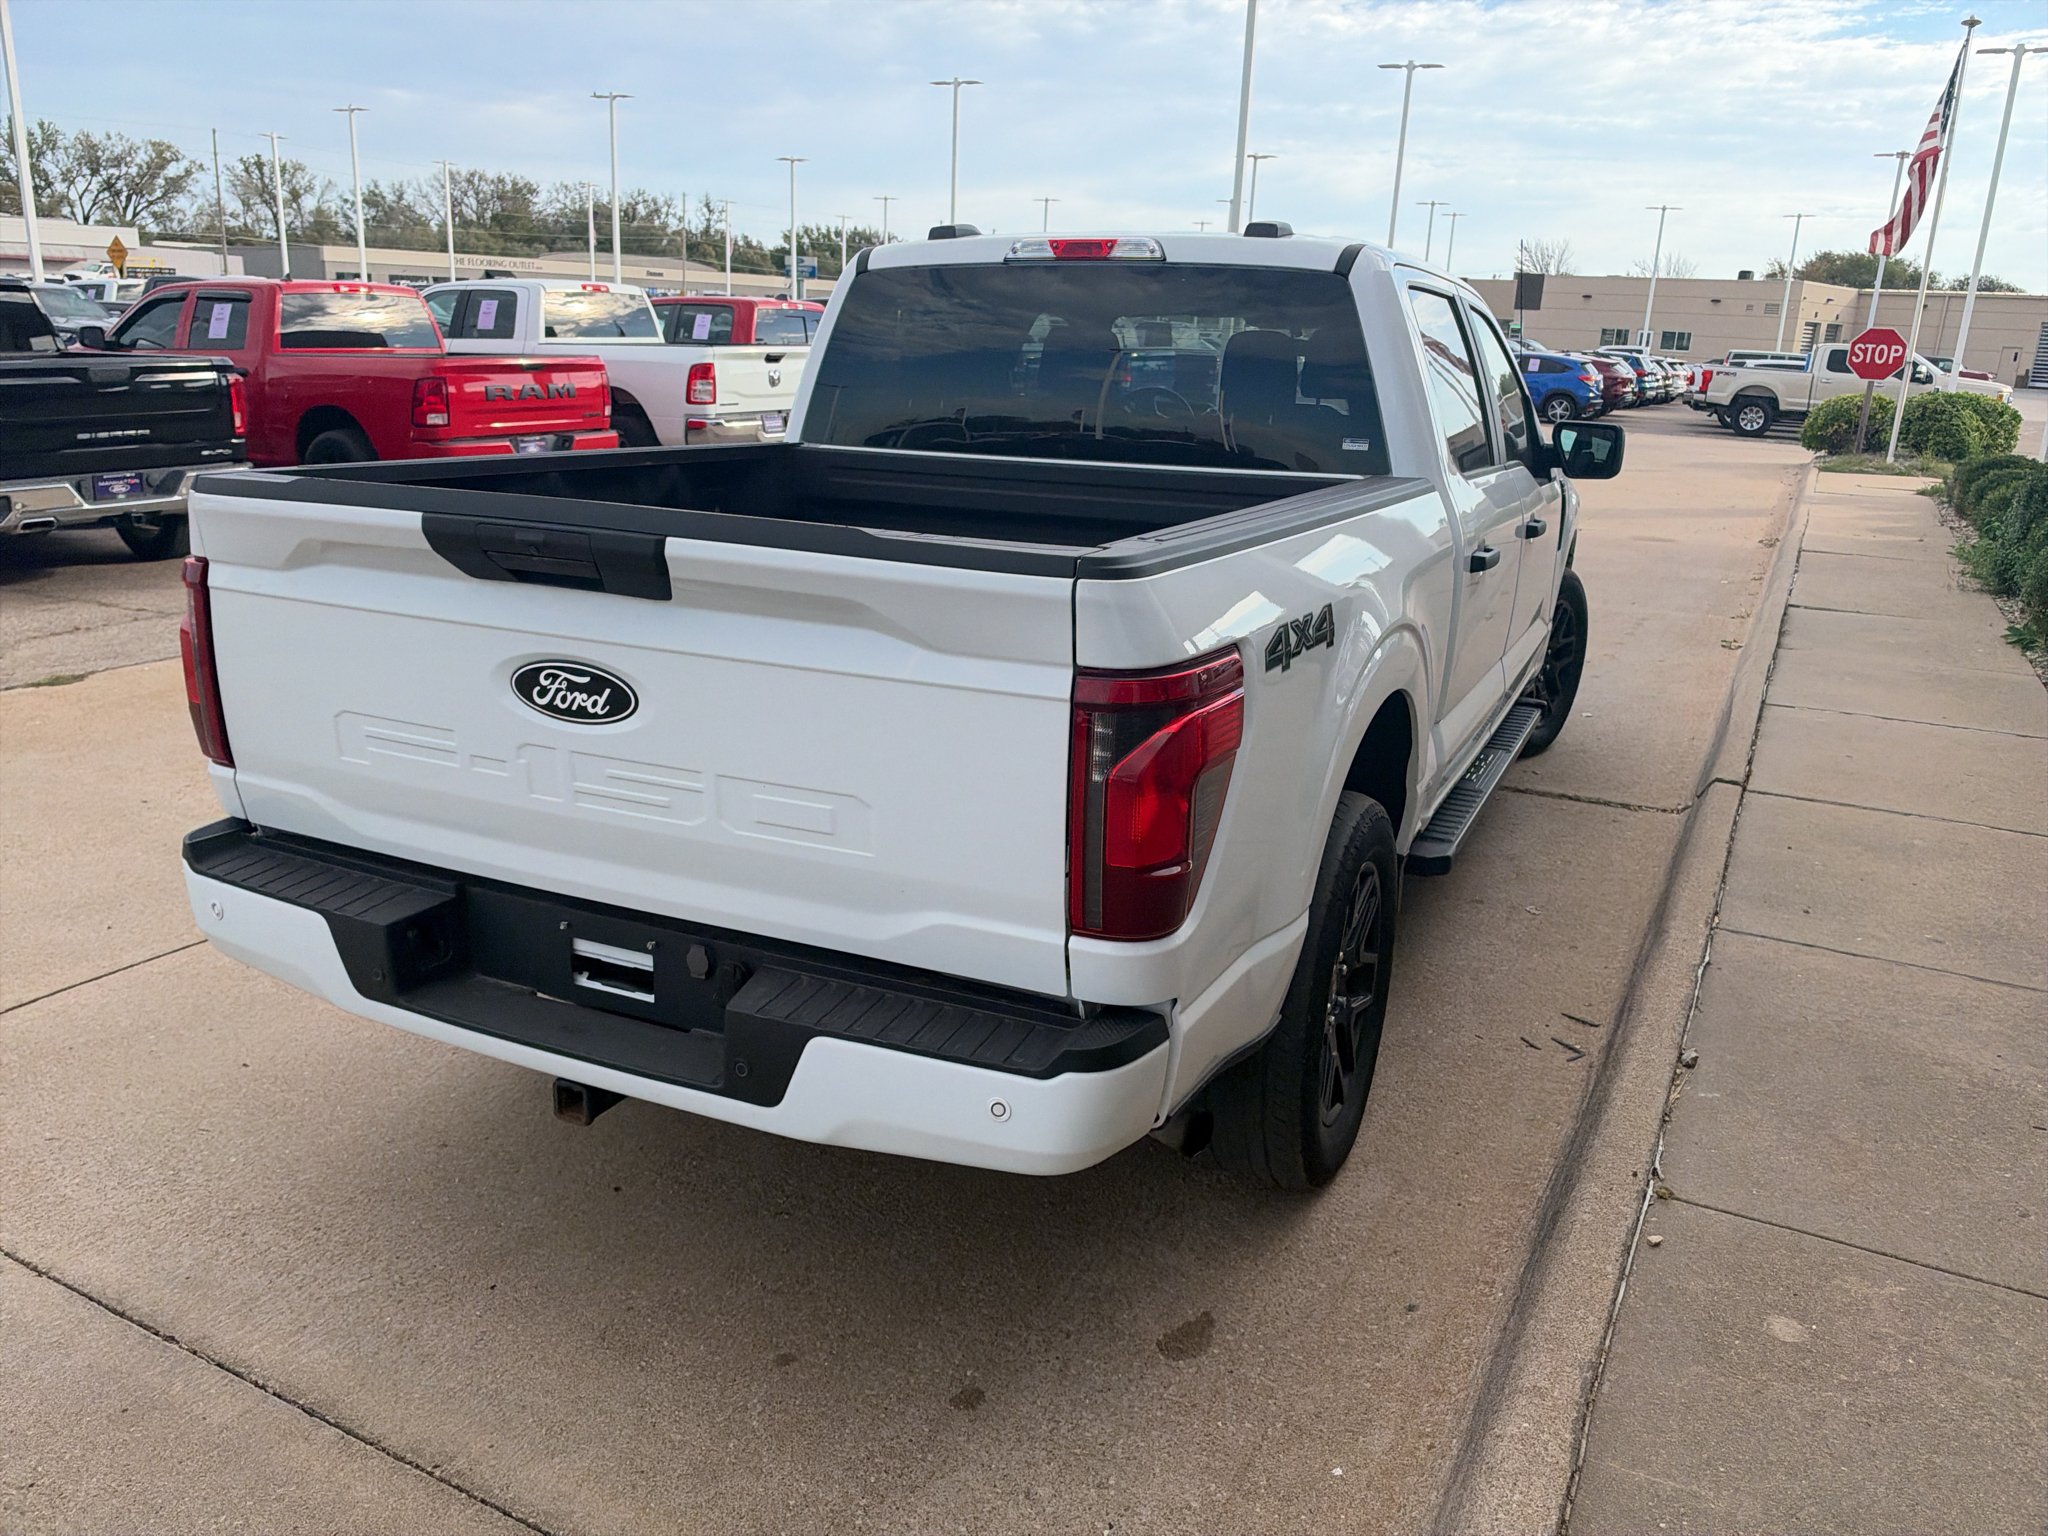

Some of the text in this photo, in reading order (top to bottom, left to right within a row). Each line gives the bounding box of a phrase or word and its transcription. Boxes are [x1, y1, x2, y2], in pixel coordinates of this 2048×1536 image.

[468, 257, 507, 269] FLOORING
[509, 260, 535, 270] OUTLET
[1851, 343, 1903, 365] STOP
[485, 383, 576, 401] RAM
[533, 669, 611, 715] Ford
[334, 709, 876, 857] F-150
